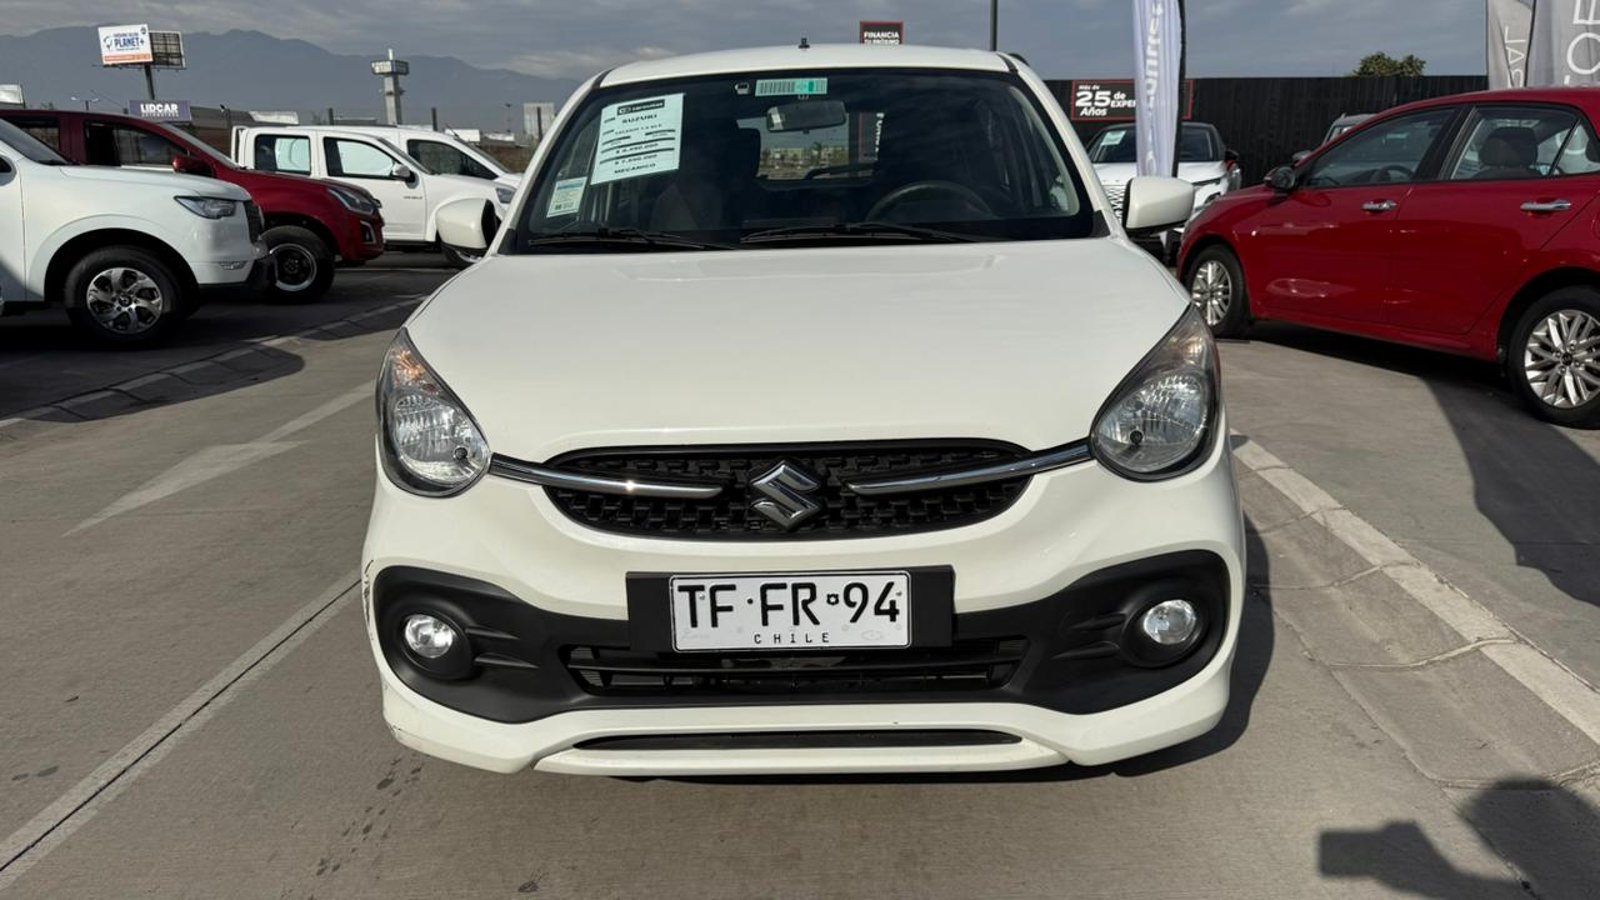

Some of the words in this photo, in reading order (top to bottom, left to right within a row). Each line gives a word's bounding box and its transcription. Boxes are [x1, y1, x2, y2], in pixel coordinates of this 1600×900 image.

[1075, 90, 1112, 107] 25
[1113, 91, 1127, 100] de
[140, 103, 178, 113] LIDCAR
[1080, 107, 1108, 116] Años
[753, 632, 829, 645] CHILE
